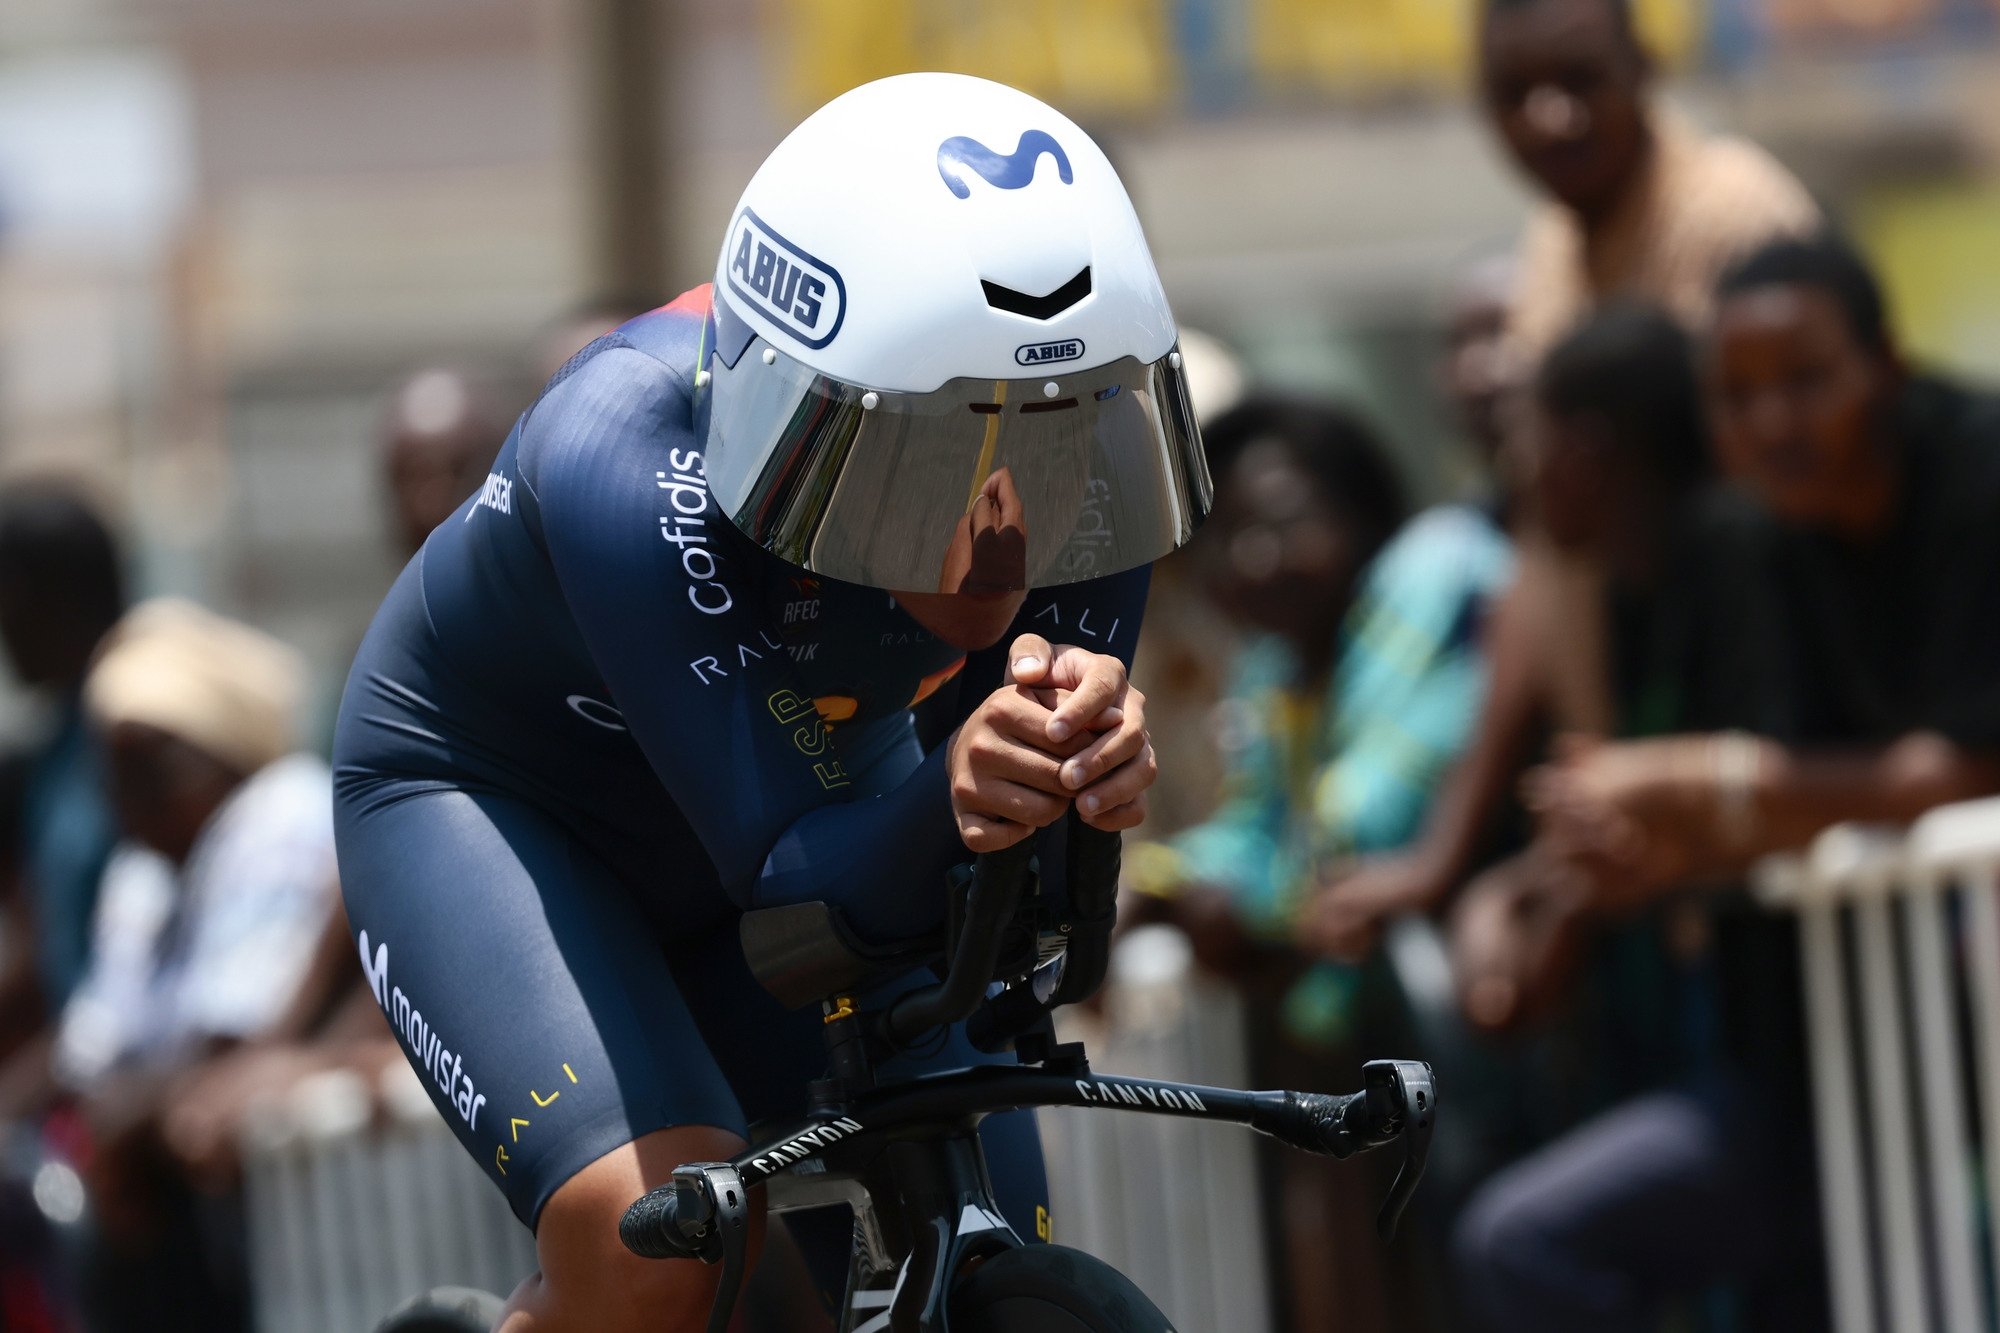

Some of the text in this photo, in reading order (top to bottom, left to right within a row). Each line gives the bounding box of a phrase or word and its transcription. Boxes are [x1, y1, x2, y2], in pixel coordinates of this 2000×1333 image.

[732, 226, 826, 329] ABUS
[1024, 342, 1078, 362] ABUS
[783, 598, 821, 624] RFEC
[1033, 601, 1120, 644] ALI
[392, 985, 487, 1132] movistar
[496, 1062, 578, 1176] RALI
[1074, 1078, 1207, 1113] CANYON
[751, 1115, 864, 1176] CANYON
